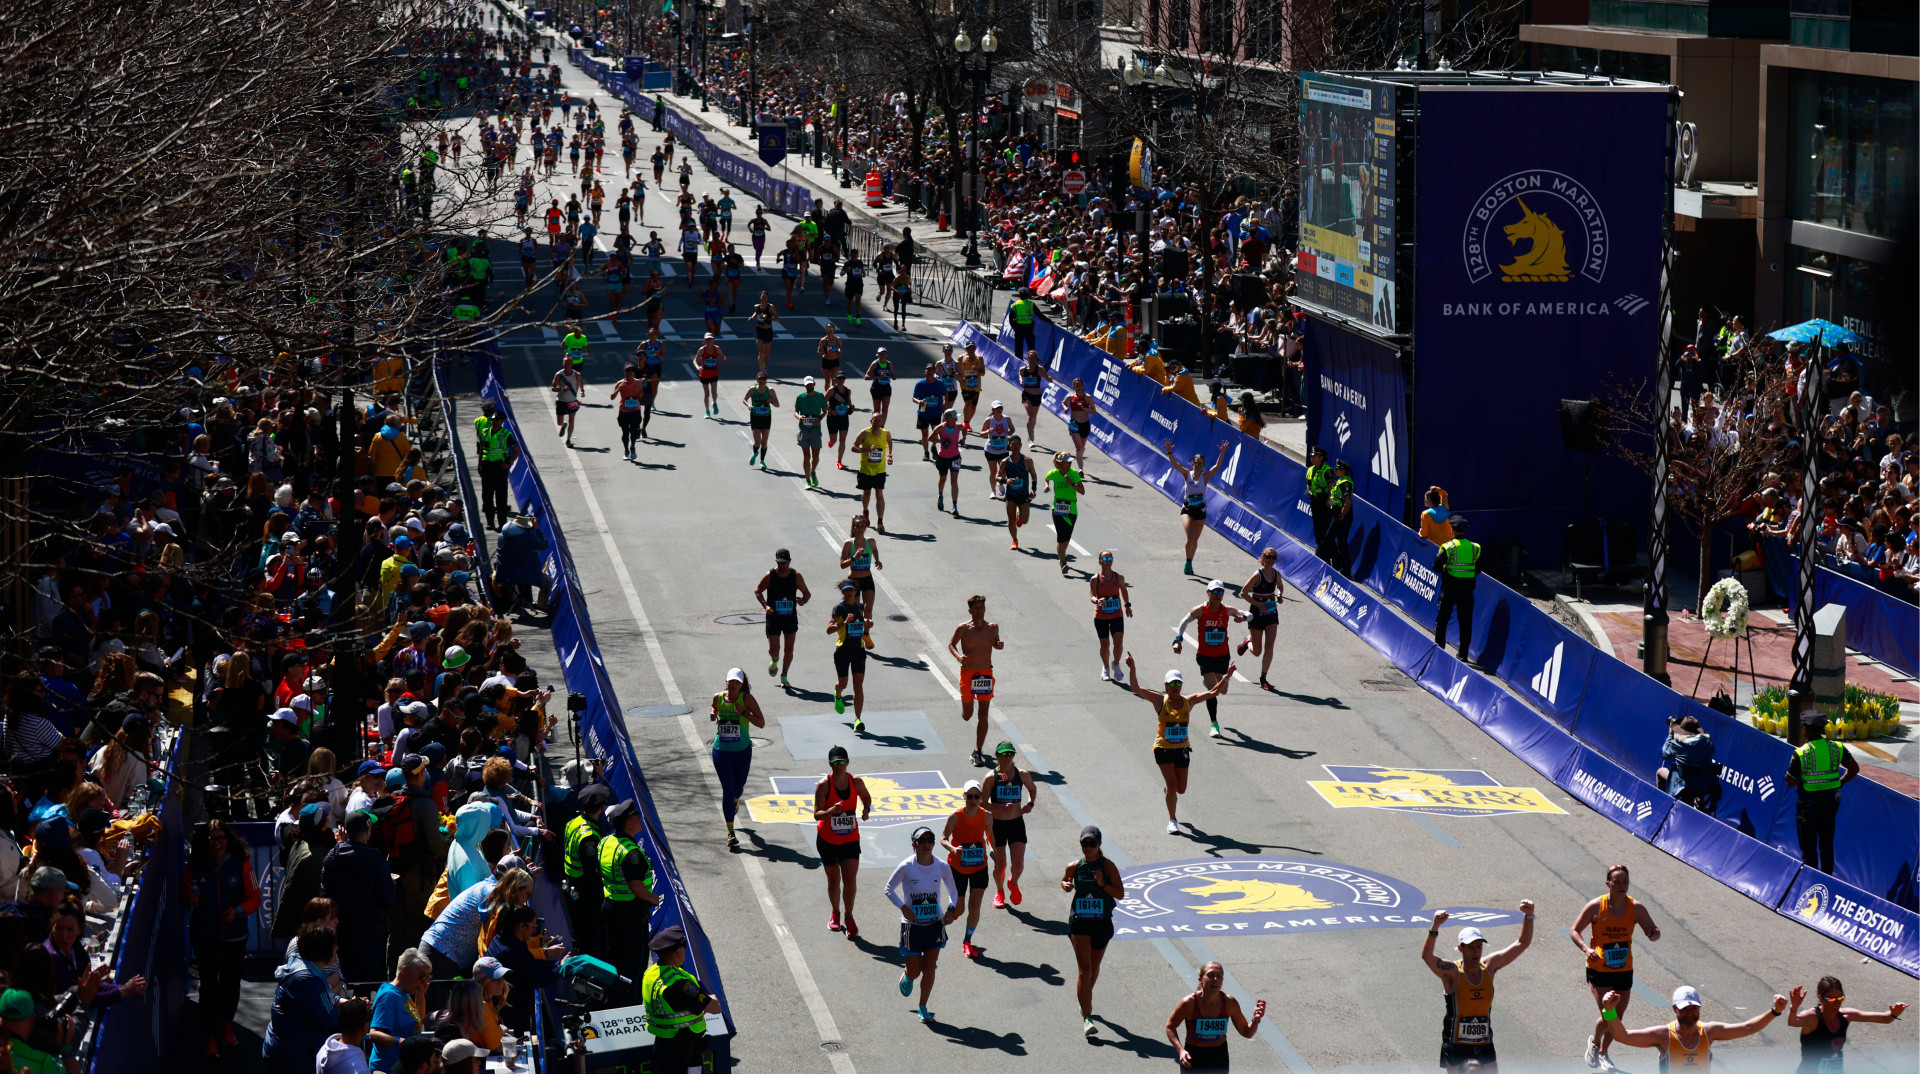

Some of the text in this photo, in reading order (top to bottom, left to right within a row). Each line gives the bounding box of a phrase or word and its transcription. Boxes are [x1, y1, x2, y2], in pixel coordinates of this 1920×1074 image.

[1476, 175, 1541, 221] BOSTON
[1552, 178, 1604, 272] MARATHON
[1443, 303, 1610, 316] BANK OF AMERICA
[1843, 316, 1874, 338] RETAIL
[1334, 382, 1343, 397] OF
[1409, 559, 1419, 575] THE
[1417, 564, 1439, 587] BOSTON
[1403, 573, 1435, 602] MARATHON
[1717, 764, 1754, 794] MERICA
[1573, 769, 1635, 814] BANK OF AMERICA
[1125, 864, 1233, 890] BOSTON
[1257, 863, 1392, 904] MARATHON
[915, 905, 937, 915] 17030
[1078, 900, 1101, 910] 16144
[1115, 915, 1432, 935] ANK OF AMERICA
[1832, 894, 1904, 939] THE BOSTON
[1818, 911, 1894, 956] MARATHON
[600, 1015, 647, 1029] 128TH BOS
[605, 1024, 647, 1037] MARAT
[1200, 1021, 1226, 1031] 19489
[1463, 1025, 1486, 1036] 10309
